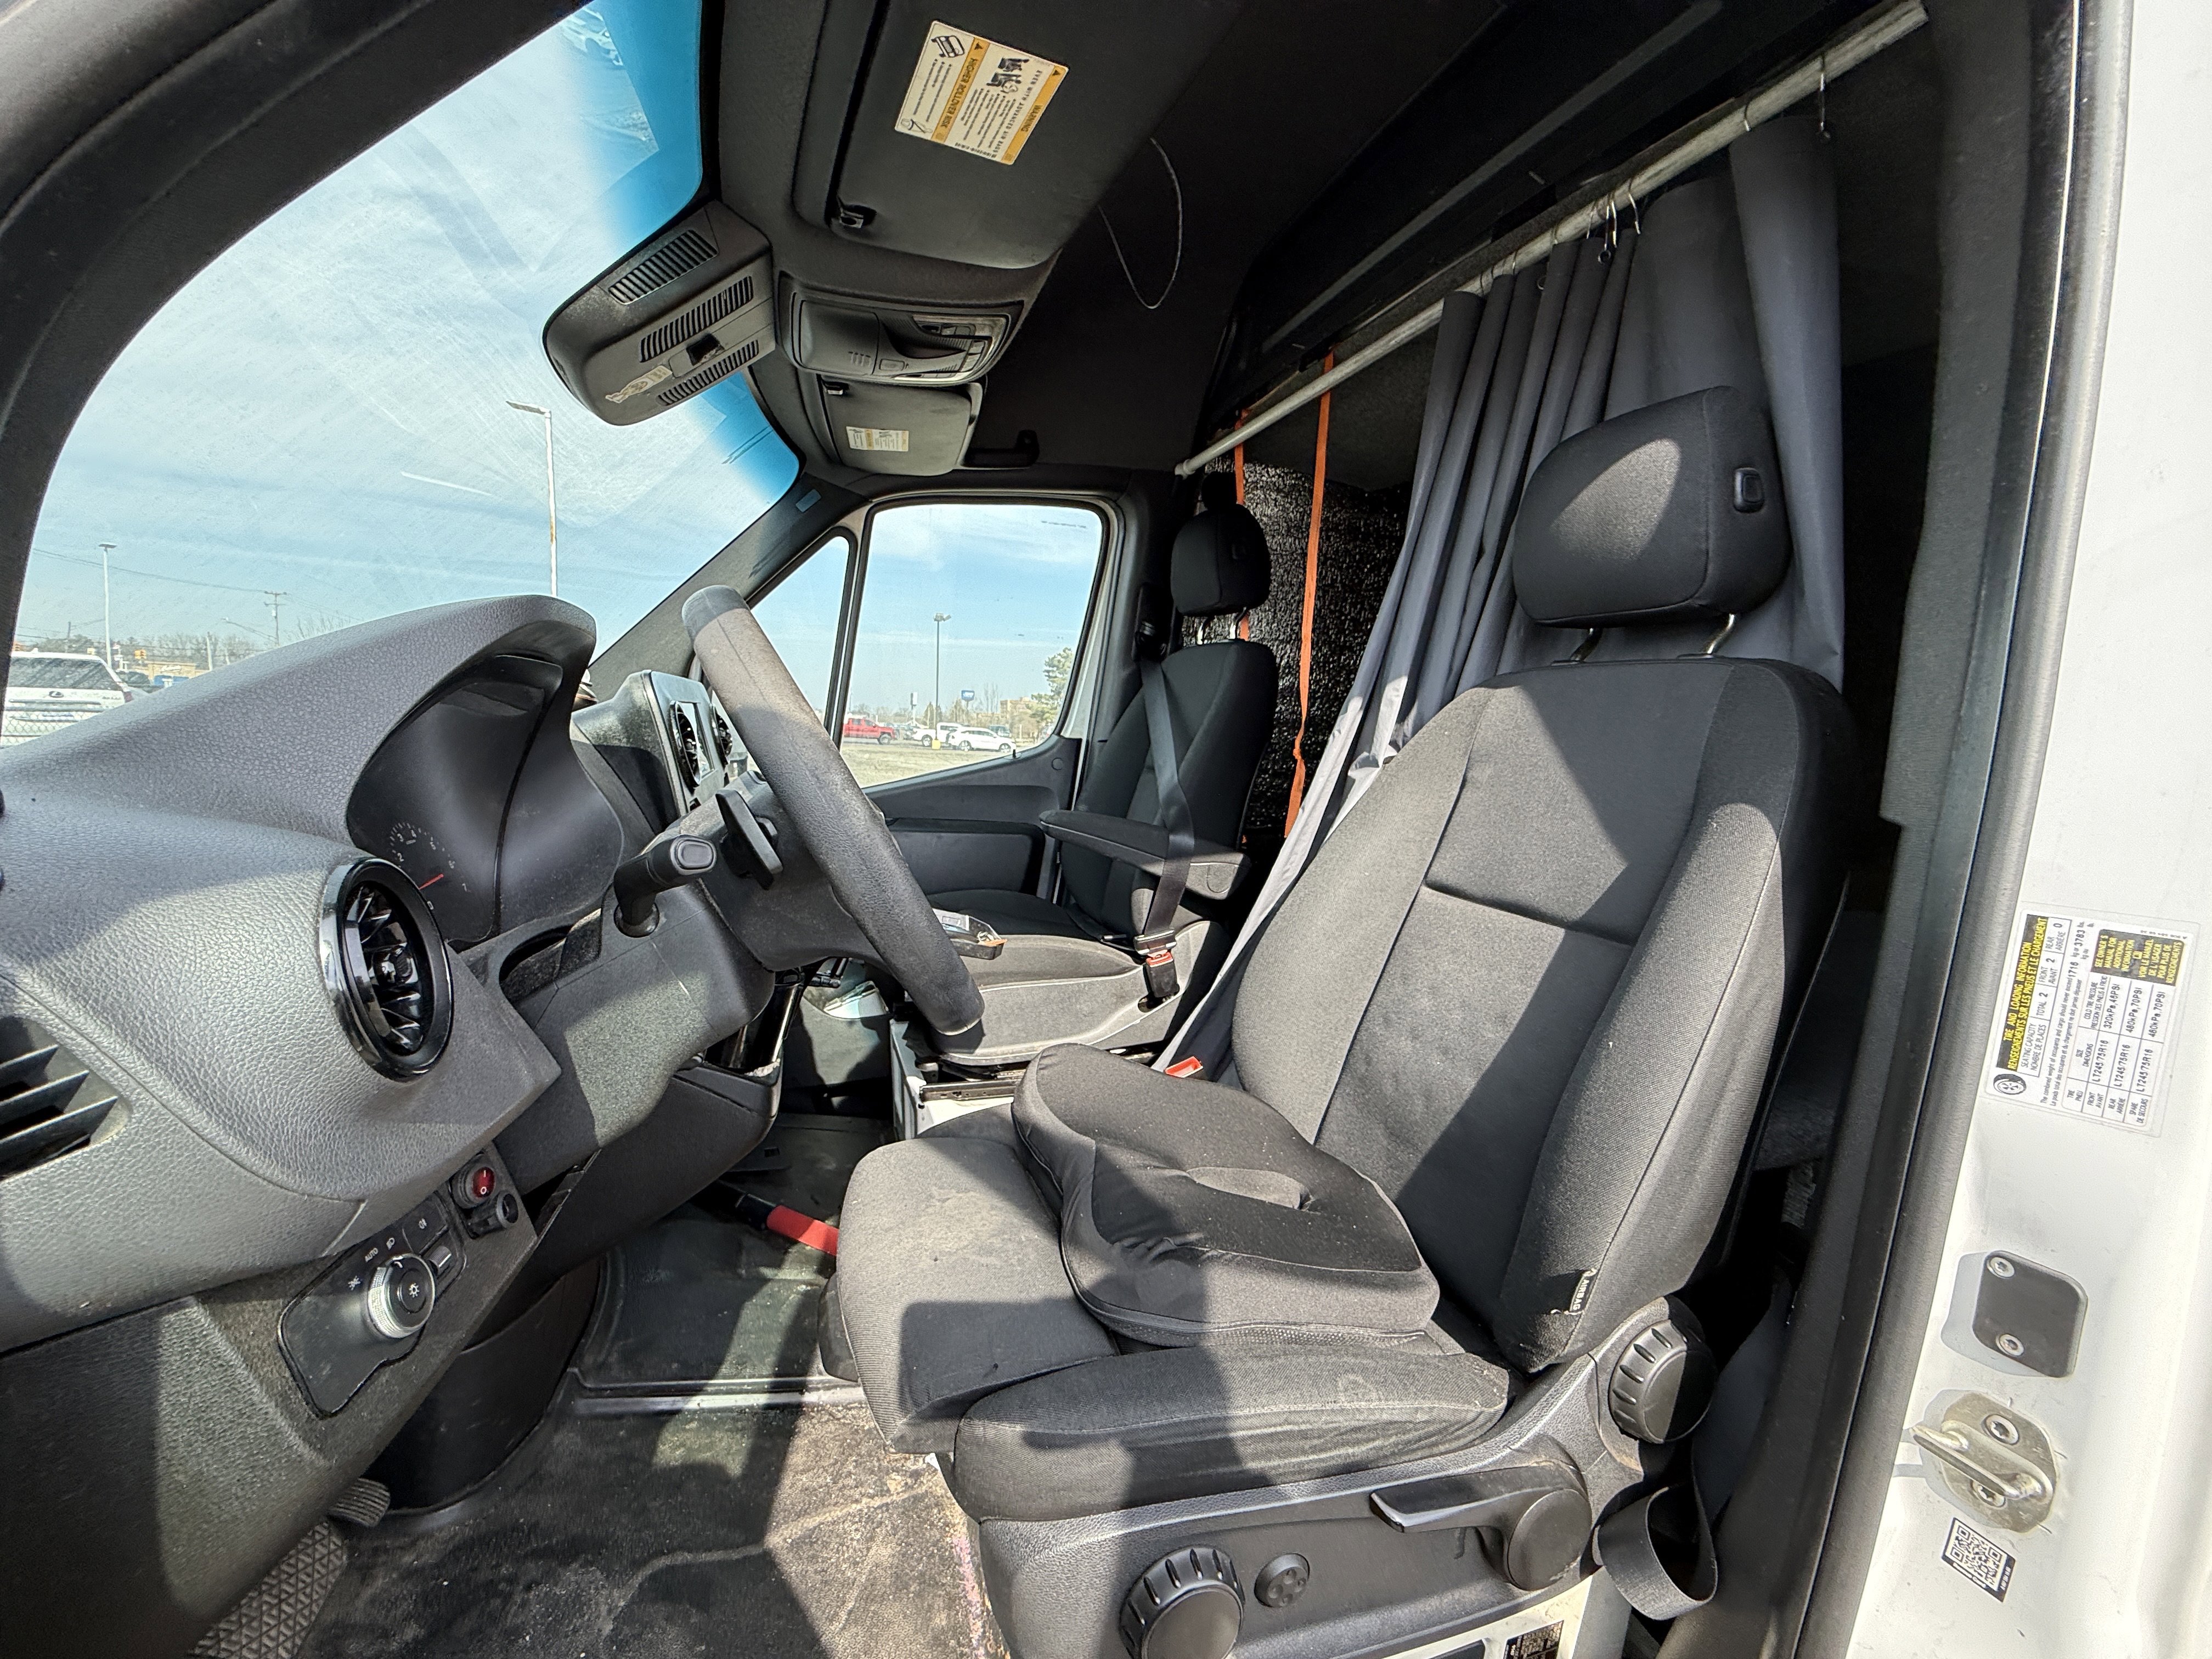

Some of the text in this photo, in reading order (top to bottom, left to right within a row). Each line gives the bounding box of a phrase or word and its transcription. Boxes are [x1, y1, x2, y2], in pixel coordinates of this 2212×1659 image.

[960, 57, 979, 84] HIGHER
[946, 83, 967, 115] ROLLOVER
[940, 114, 952, 128] RISK
[1020, 103, 1042, 133] WARNING
[397, 833, 404, 842] 3
[397, 852, 404, 862] 2
[2045, 936, 2055, 949] REAR
[2073, 929, 2085, 946] 3783
[2103, 937, 2117, 968] MANUAL FOR
[2112, 939, 2125, 968] ADDITIONAL
[2120, 939, 2135, 972] INFORMATION
[2142, 938, 2154, 958] MANUEL
[2094, 958, 2103, 967] SEE
[2159, 951, 2170, 964] PLUS
[2165, 941, 2182, 984] RENSEIGNEMENTS
[2038, 966, 2048, 983] FRONT
[2047, 968, 2058, 984] AVANT
[2137, 966, 2148, 978] VOIR
[2156, 964, 2167, 978] POUR
[2002, 941, 2032, 1041] TIRE AND LOADING INFORMATION
[2007, 917, 2047, 1069] RENSEIGNEMENTS SUR LES PNEUS ET LE CHARGEMENT
[2036, 1000, 2046, 1016] TOTAL
[2035, 1024, 2046, 1043] PLACES
[2020, 1022, 2036, 1068] SEATING CAPACITY
[365, 1247, 379, 1263] AUTO
[1572, 1279, 1590, 1311] AIRBAG
